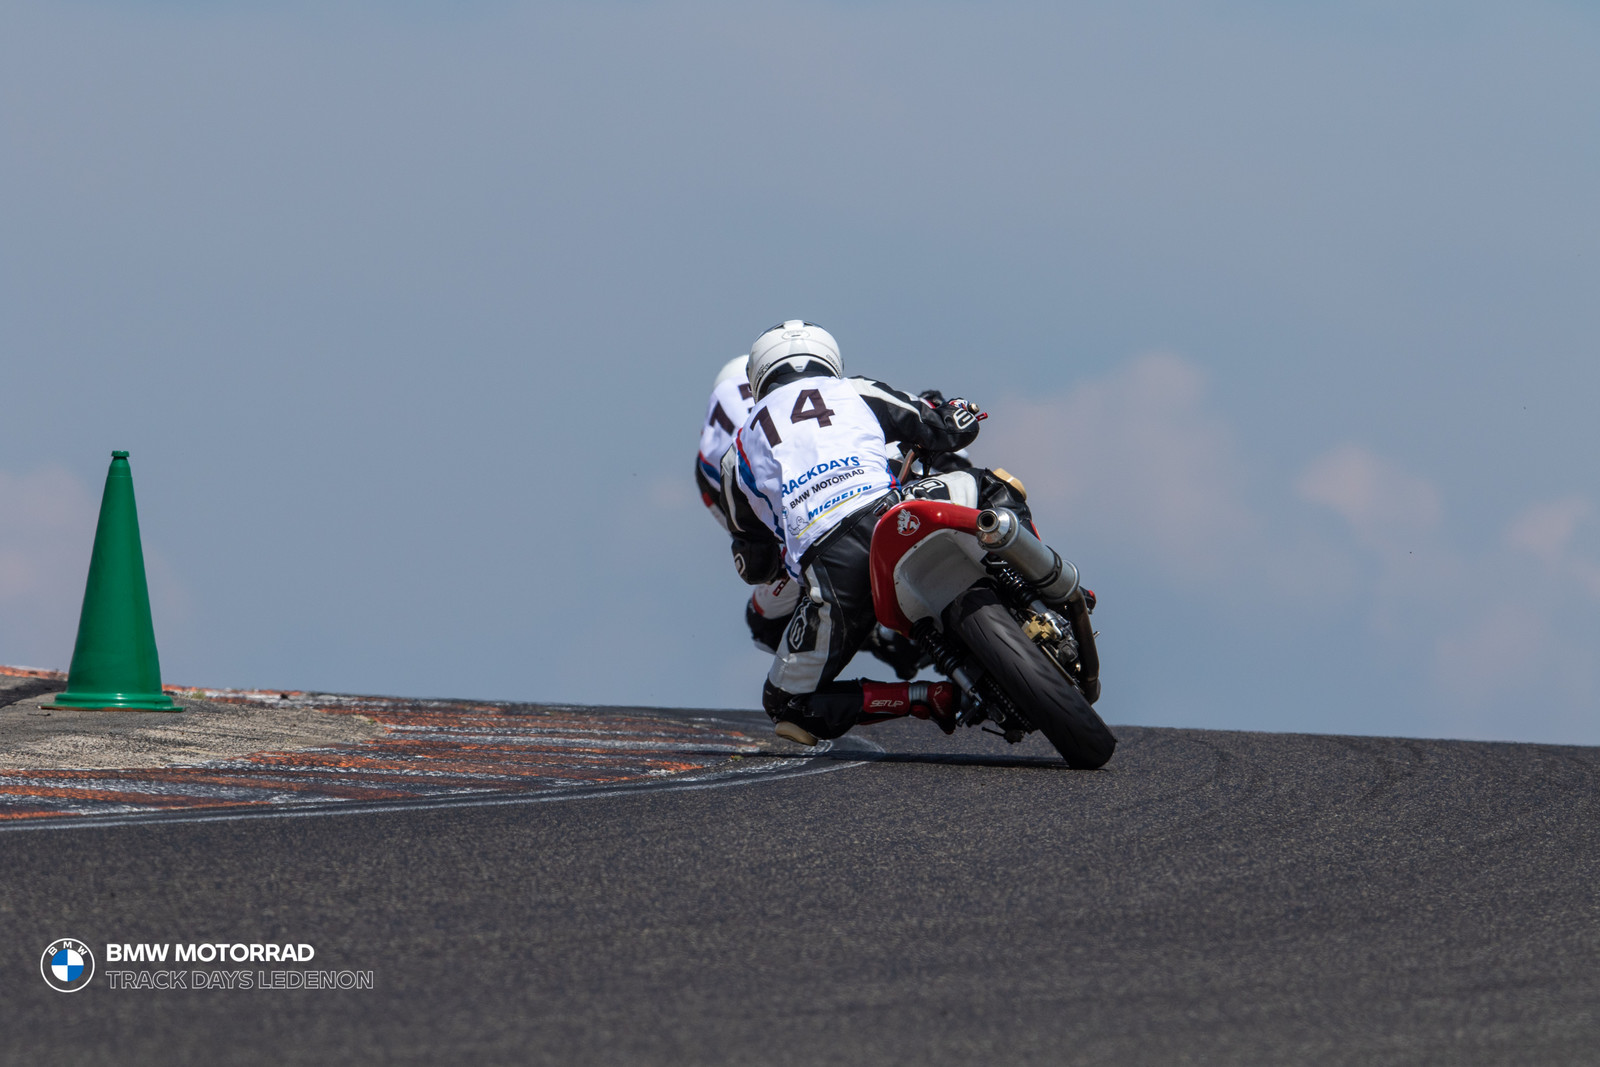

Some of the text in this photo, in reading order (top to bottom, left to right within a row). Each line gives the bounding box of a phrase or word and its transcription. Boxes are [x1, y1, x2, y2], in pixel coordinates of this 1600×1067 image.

[749, 388, 836, 448] 14
[782, 456, 860, 498] RACKDAYS
[789, 468, 865, 509] BMW MOTORRAD
[808, 485, 872, 521] MICHELIN
